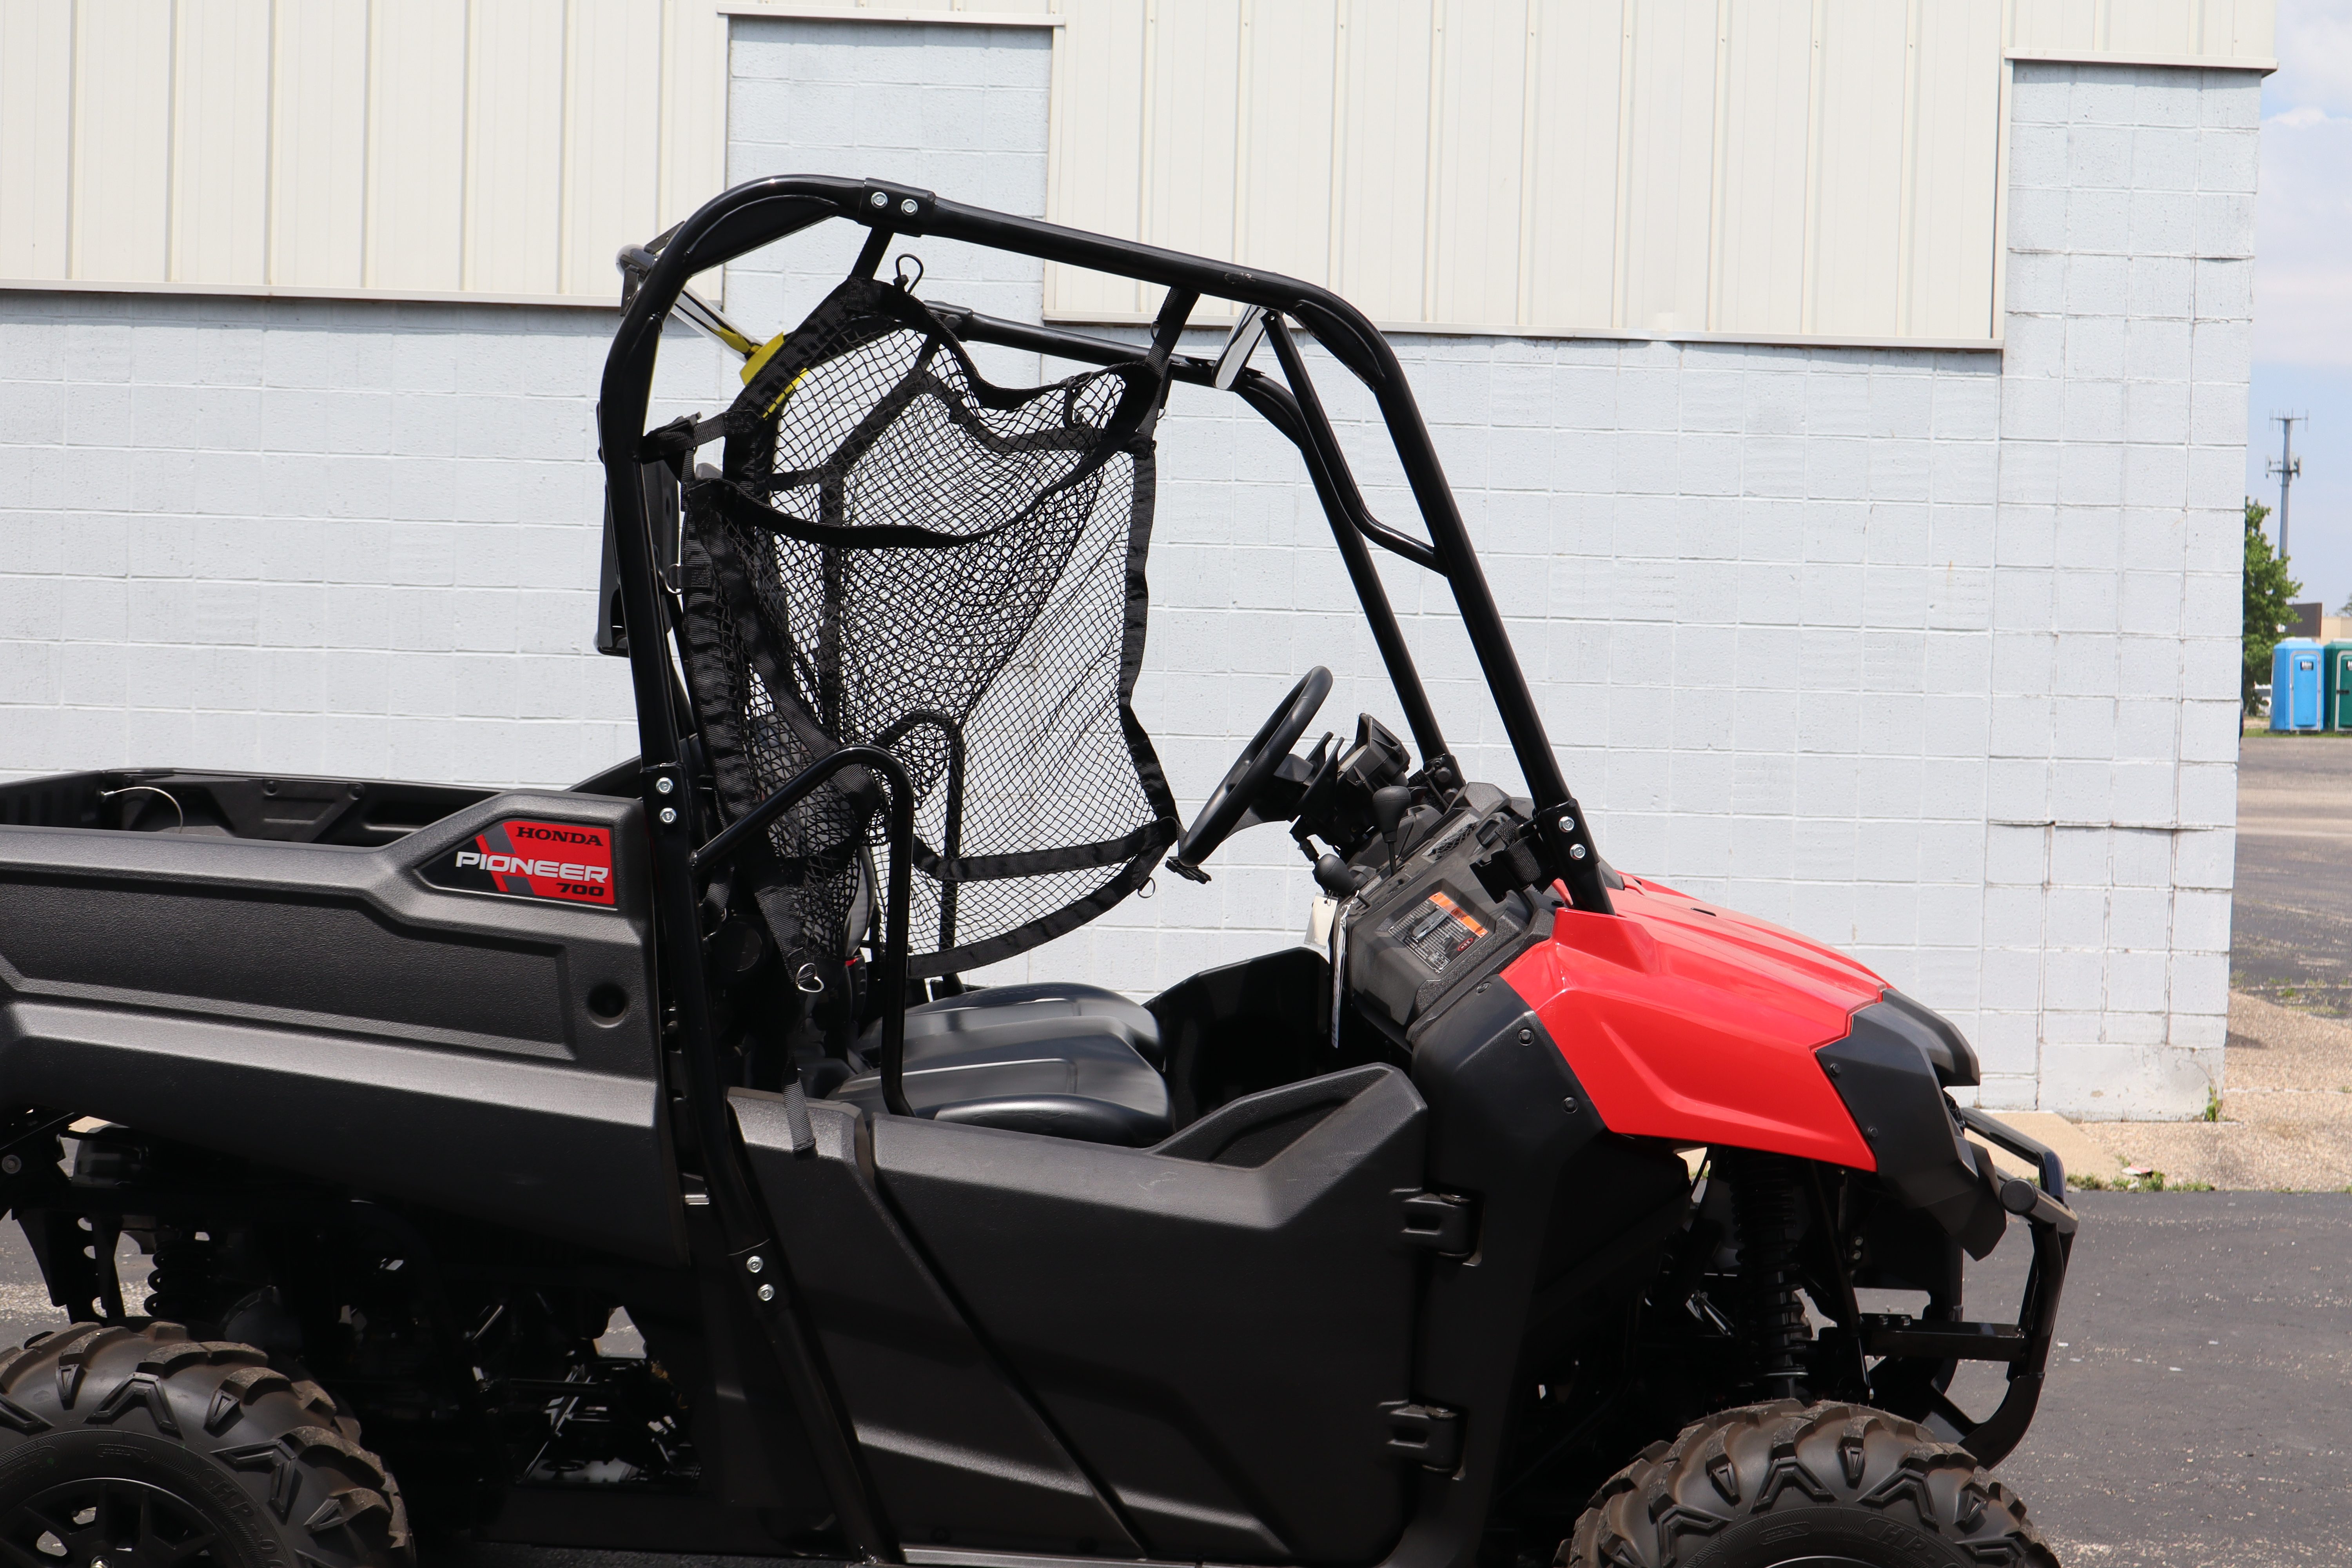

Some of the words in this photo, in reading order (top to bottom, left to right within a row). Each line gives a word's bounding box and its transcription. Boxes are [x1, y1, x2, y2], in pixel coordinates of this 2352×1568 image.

[516, 826, 604, 847] HONDA
[456, 851, 609, 884] PIONEER
[556, 882, 604, 897] 700
